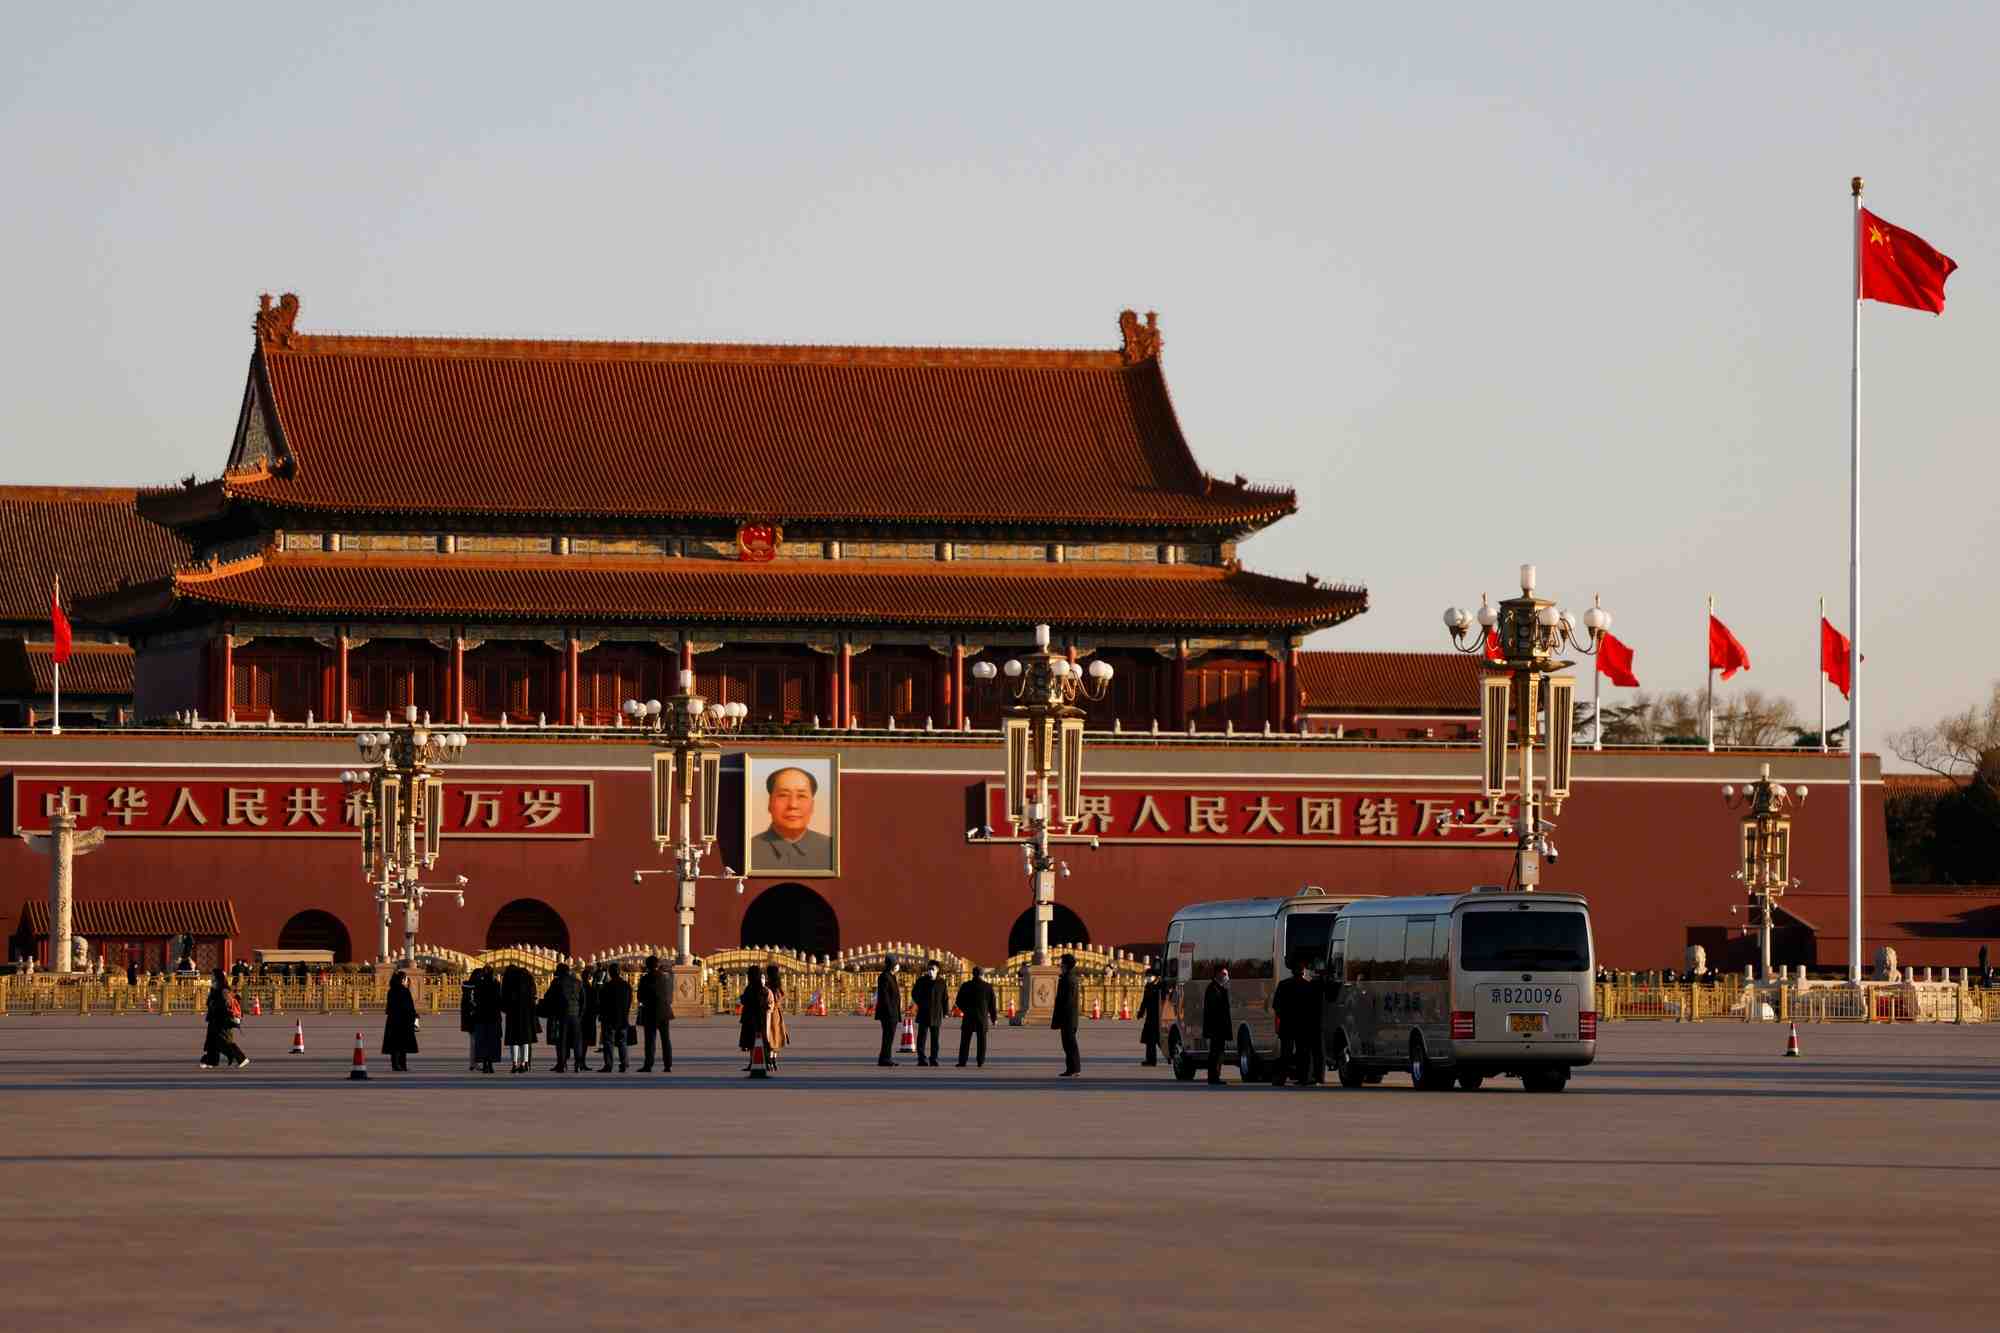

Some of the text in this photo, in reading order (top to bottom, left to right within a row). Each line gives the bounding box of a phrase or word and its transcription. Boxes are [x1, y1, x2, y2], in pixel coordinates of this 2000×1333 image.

[45, 786, 562, 828] 中华人民共万岁
